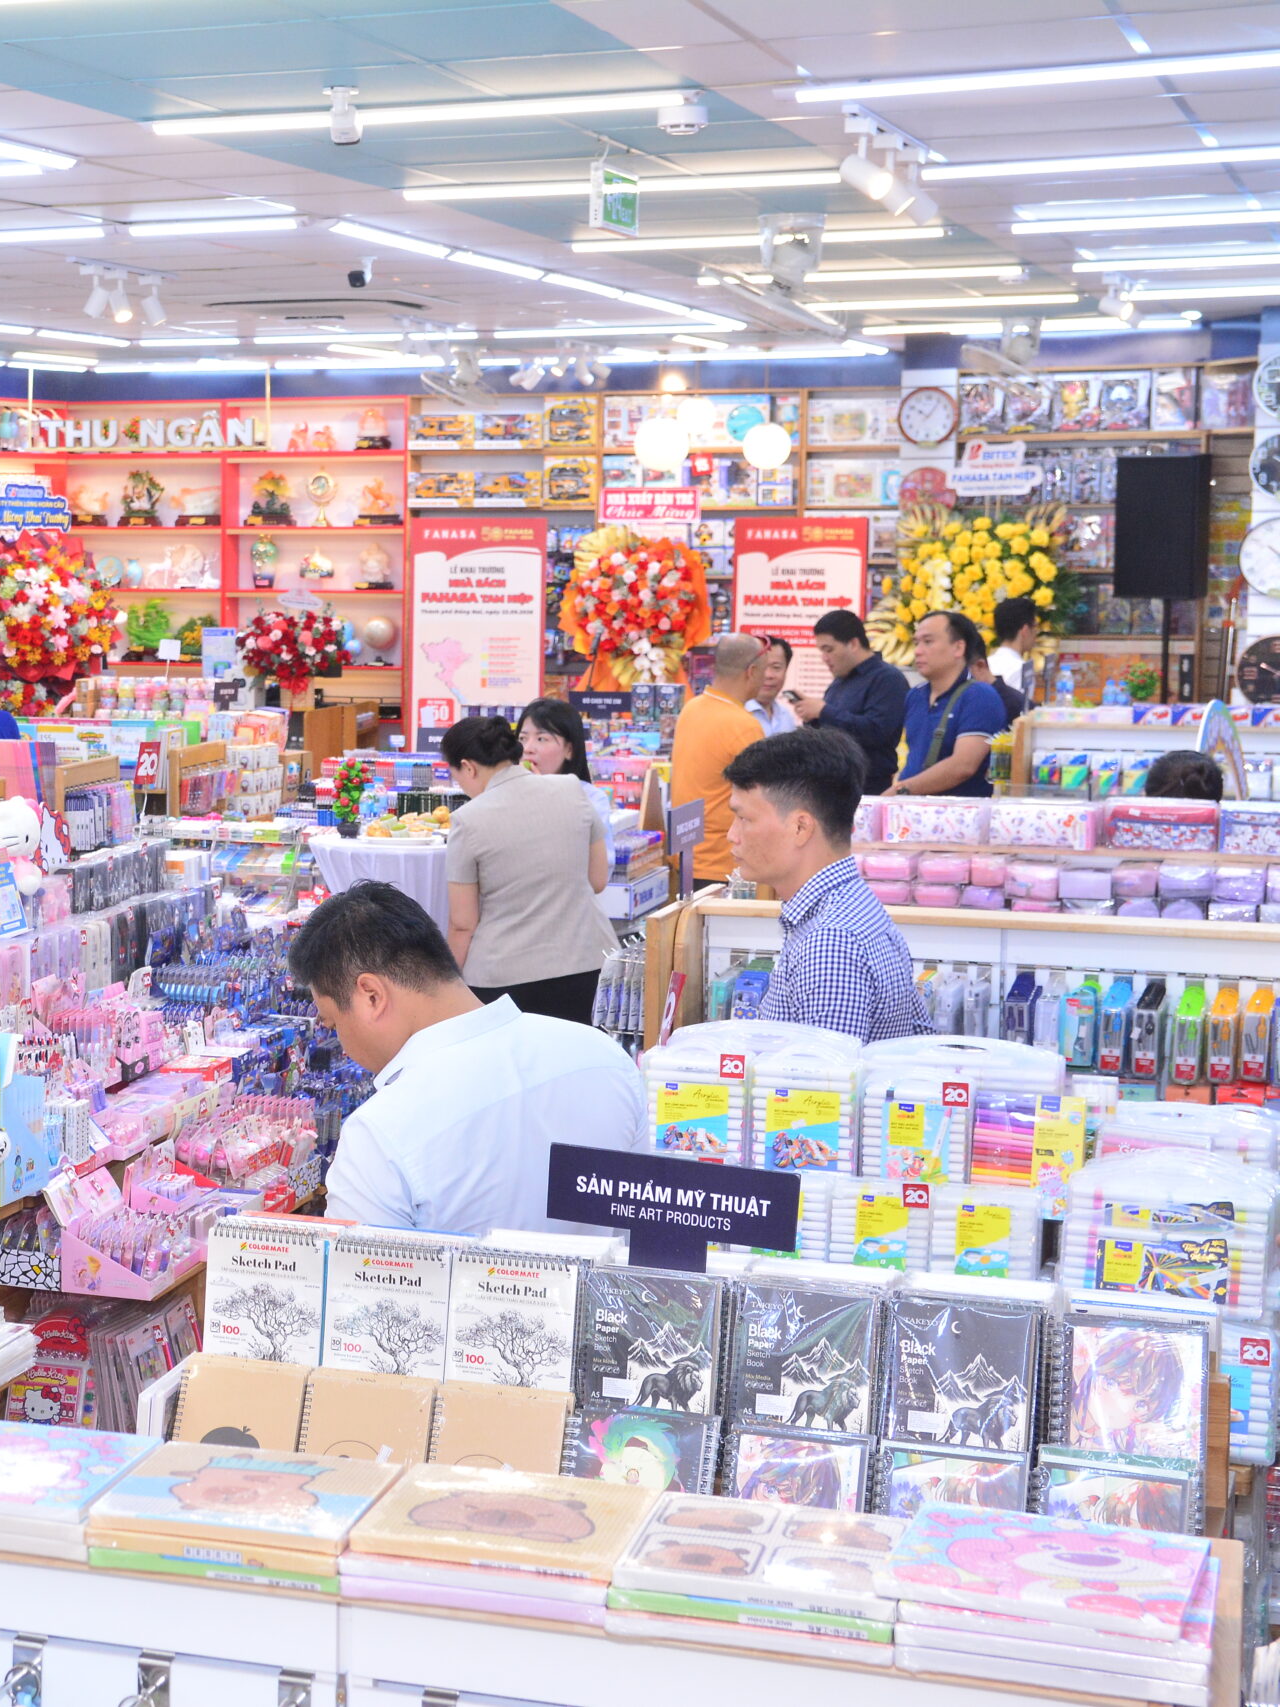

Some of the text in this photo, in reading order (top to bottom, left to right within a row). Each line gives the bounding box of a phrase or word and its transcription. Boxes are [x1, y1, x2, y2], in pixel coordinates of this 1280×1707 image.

[41, 411, 256, 447] THU NGÂN
[424, 529, 476, 539] FAHASA
[747, 529, 798, 540] FAHASA
[421, 592, 478, 604] FAHASA
[744, 595, 799, 607] FAHASA
[576, 1173, 771, 1218] SẢN PHẨM MỸ THUẬT
[610, 1203, 731, 1231] FINE ART PRODUCTS
[249, 1243, 289, 1253] COLORMATE
[231, 1256, 296, 1272] Sketch Pad
[371, 1258, 414, 1269] COLORMATE
[497, 1267, 540, 1278] COLORMATE
[354, 1271, 422, 1288] Sketch Pad
[478, 1281, 547, 1299] Sketch Pad
[598, 1286, 630, 1297] TAKEYO
[751, 1301, 785, 1311] TAKEYO
[595, 1309, 628, 1325] Black
[904, 1316, 939, 1326] TAKEYO
[222, 1325, 240, 1335] 100
[595, 1324, 620, 1335] Paper
[748, 1323, 782, 1341] Black
[594, 1334, 617, 1343] Sketch
[747, 1338, 771, 1350] Paper
[344, 1343, 362, 1353] 100
[594, 1343, 612, 1352] Book
[900, 1339, 936, 1356] Black
[747, 1349, 771, 1359] Sketch
[466, 1355, 485, 1365] 100
[746, 1359, 765, 1368] Book
[900, 1355, 928, 1366] Paper
[899, 1365, 924, 1375] Sketch
[899, 1375, 917, 1385] Book
[591, 1390, 600, 1399] A5
